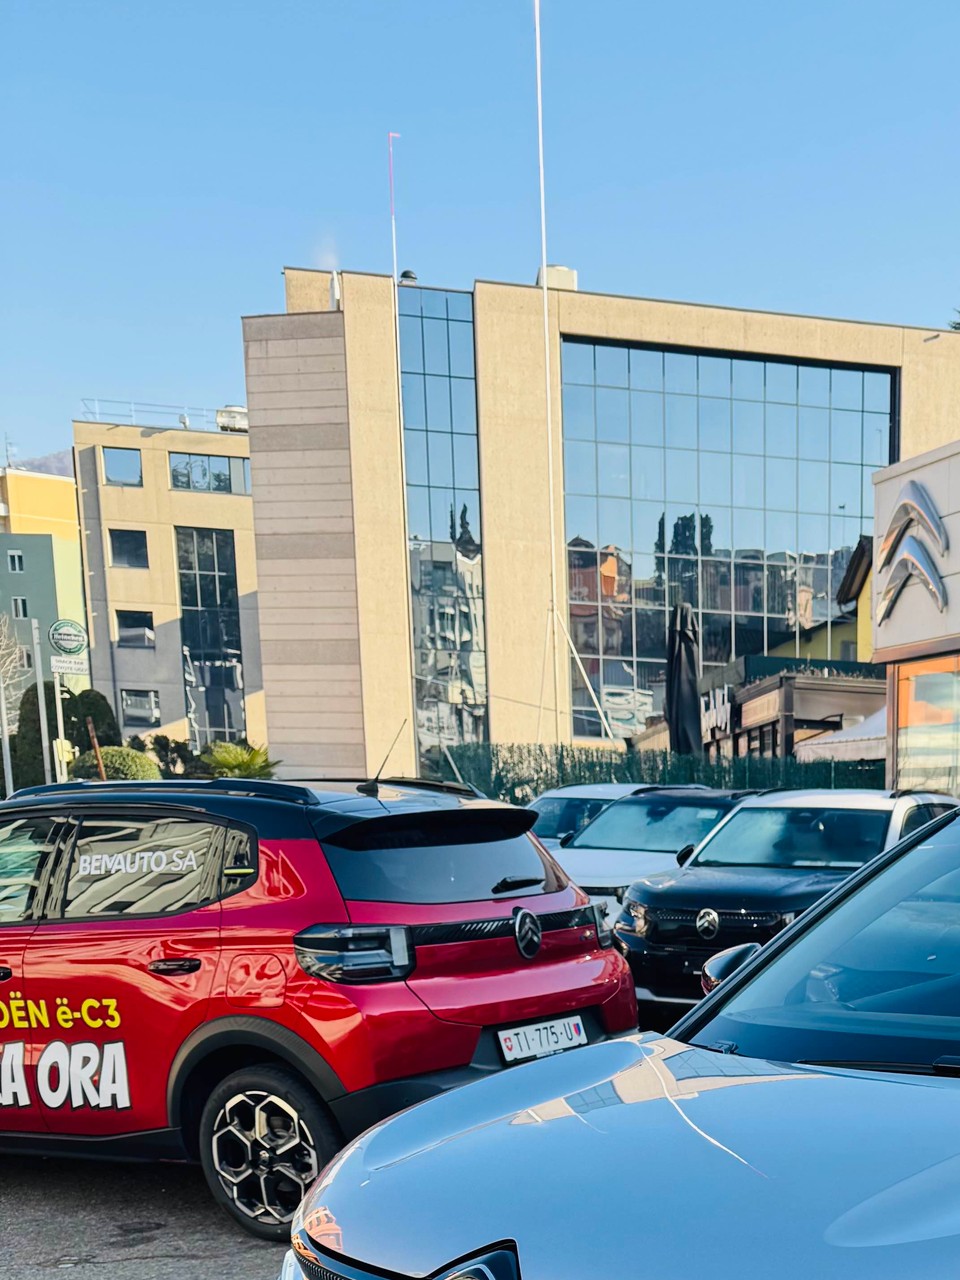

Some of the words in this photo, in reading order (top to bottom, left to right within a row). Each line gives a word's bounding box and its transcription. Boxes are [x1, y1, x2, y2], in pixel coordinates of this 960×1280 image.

[79, 851, 167, 875] BEMAUTO
[170, 849, 198, 871] SA
[56, 997, 121, 1028] ë-C3
[37, 1039, 132, 1110] ORA
